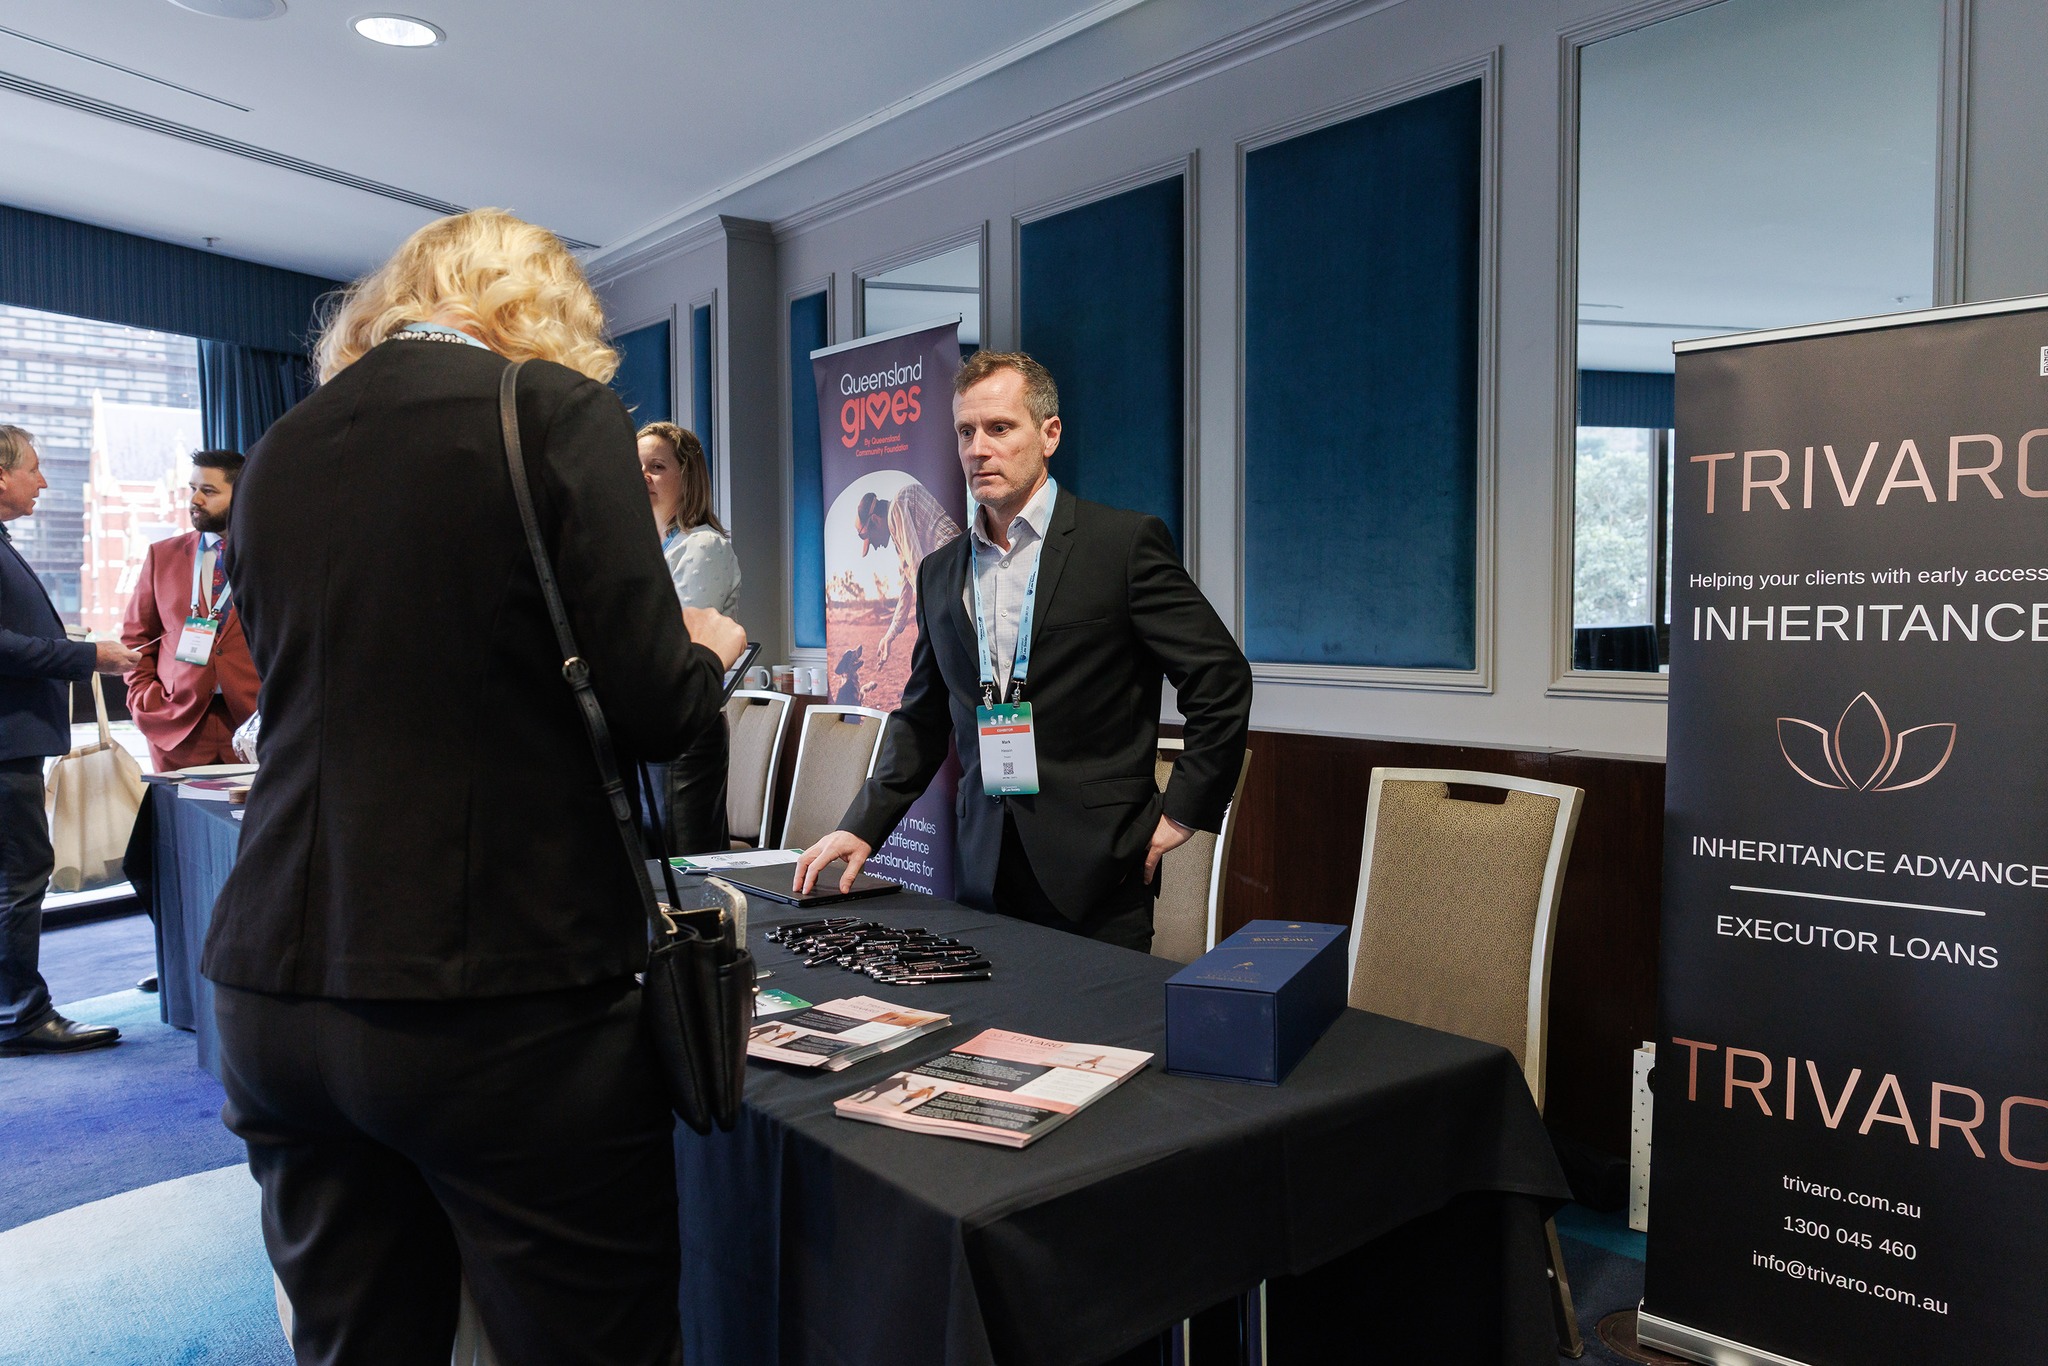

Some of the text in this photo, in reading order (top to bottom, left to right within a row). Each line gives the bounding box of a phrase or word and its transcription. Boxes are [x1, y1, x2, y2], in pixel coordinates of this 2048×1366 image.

[840, 354, 922, 396] Queensland
[840, 386, 922, 448] gives
[856, 444, 908, 457] Community Foundation
[864, 433, 901, 448] By Queensland
[1689, 566, 2048, 591] Helping your clients with early access
[888, 832, 930, 855] difference
[910, 817, 936, 834] makes
[922, 861, 934, 877] for
[1692, 836, 1886, 873] INHERITANCE
[1716, 915, 1999, 969] EXECUTOR LOANS
[1010, 1036, 1064, 1048] TRIVARO
[1672, 1037, 2048, 1171] TRIVARO
[1783, 1174, 1921, 1219] trivaro.com.au
[1783, 1215, 1917, 1261] 1300 045 460
[1752, 1250, 1948, 1315] info@trivaro.com.au
